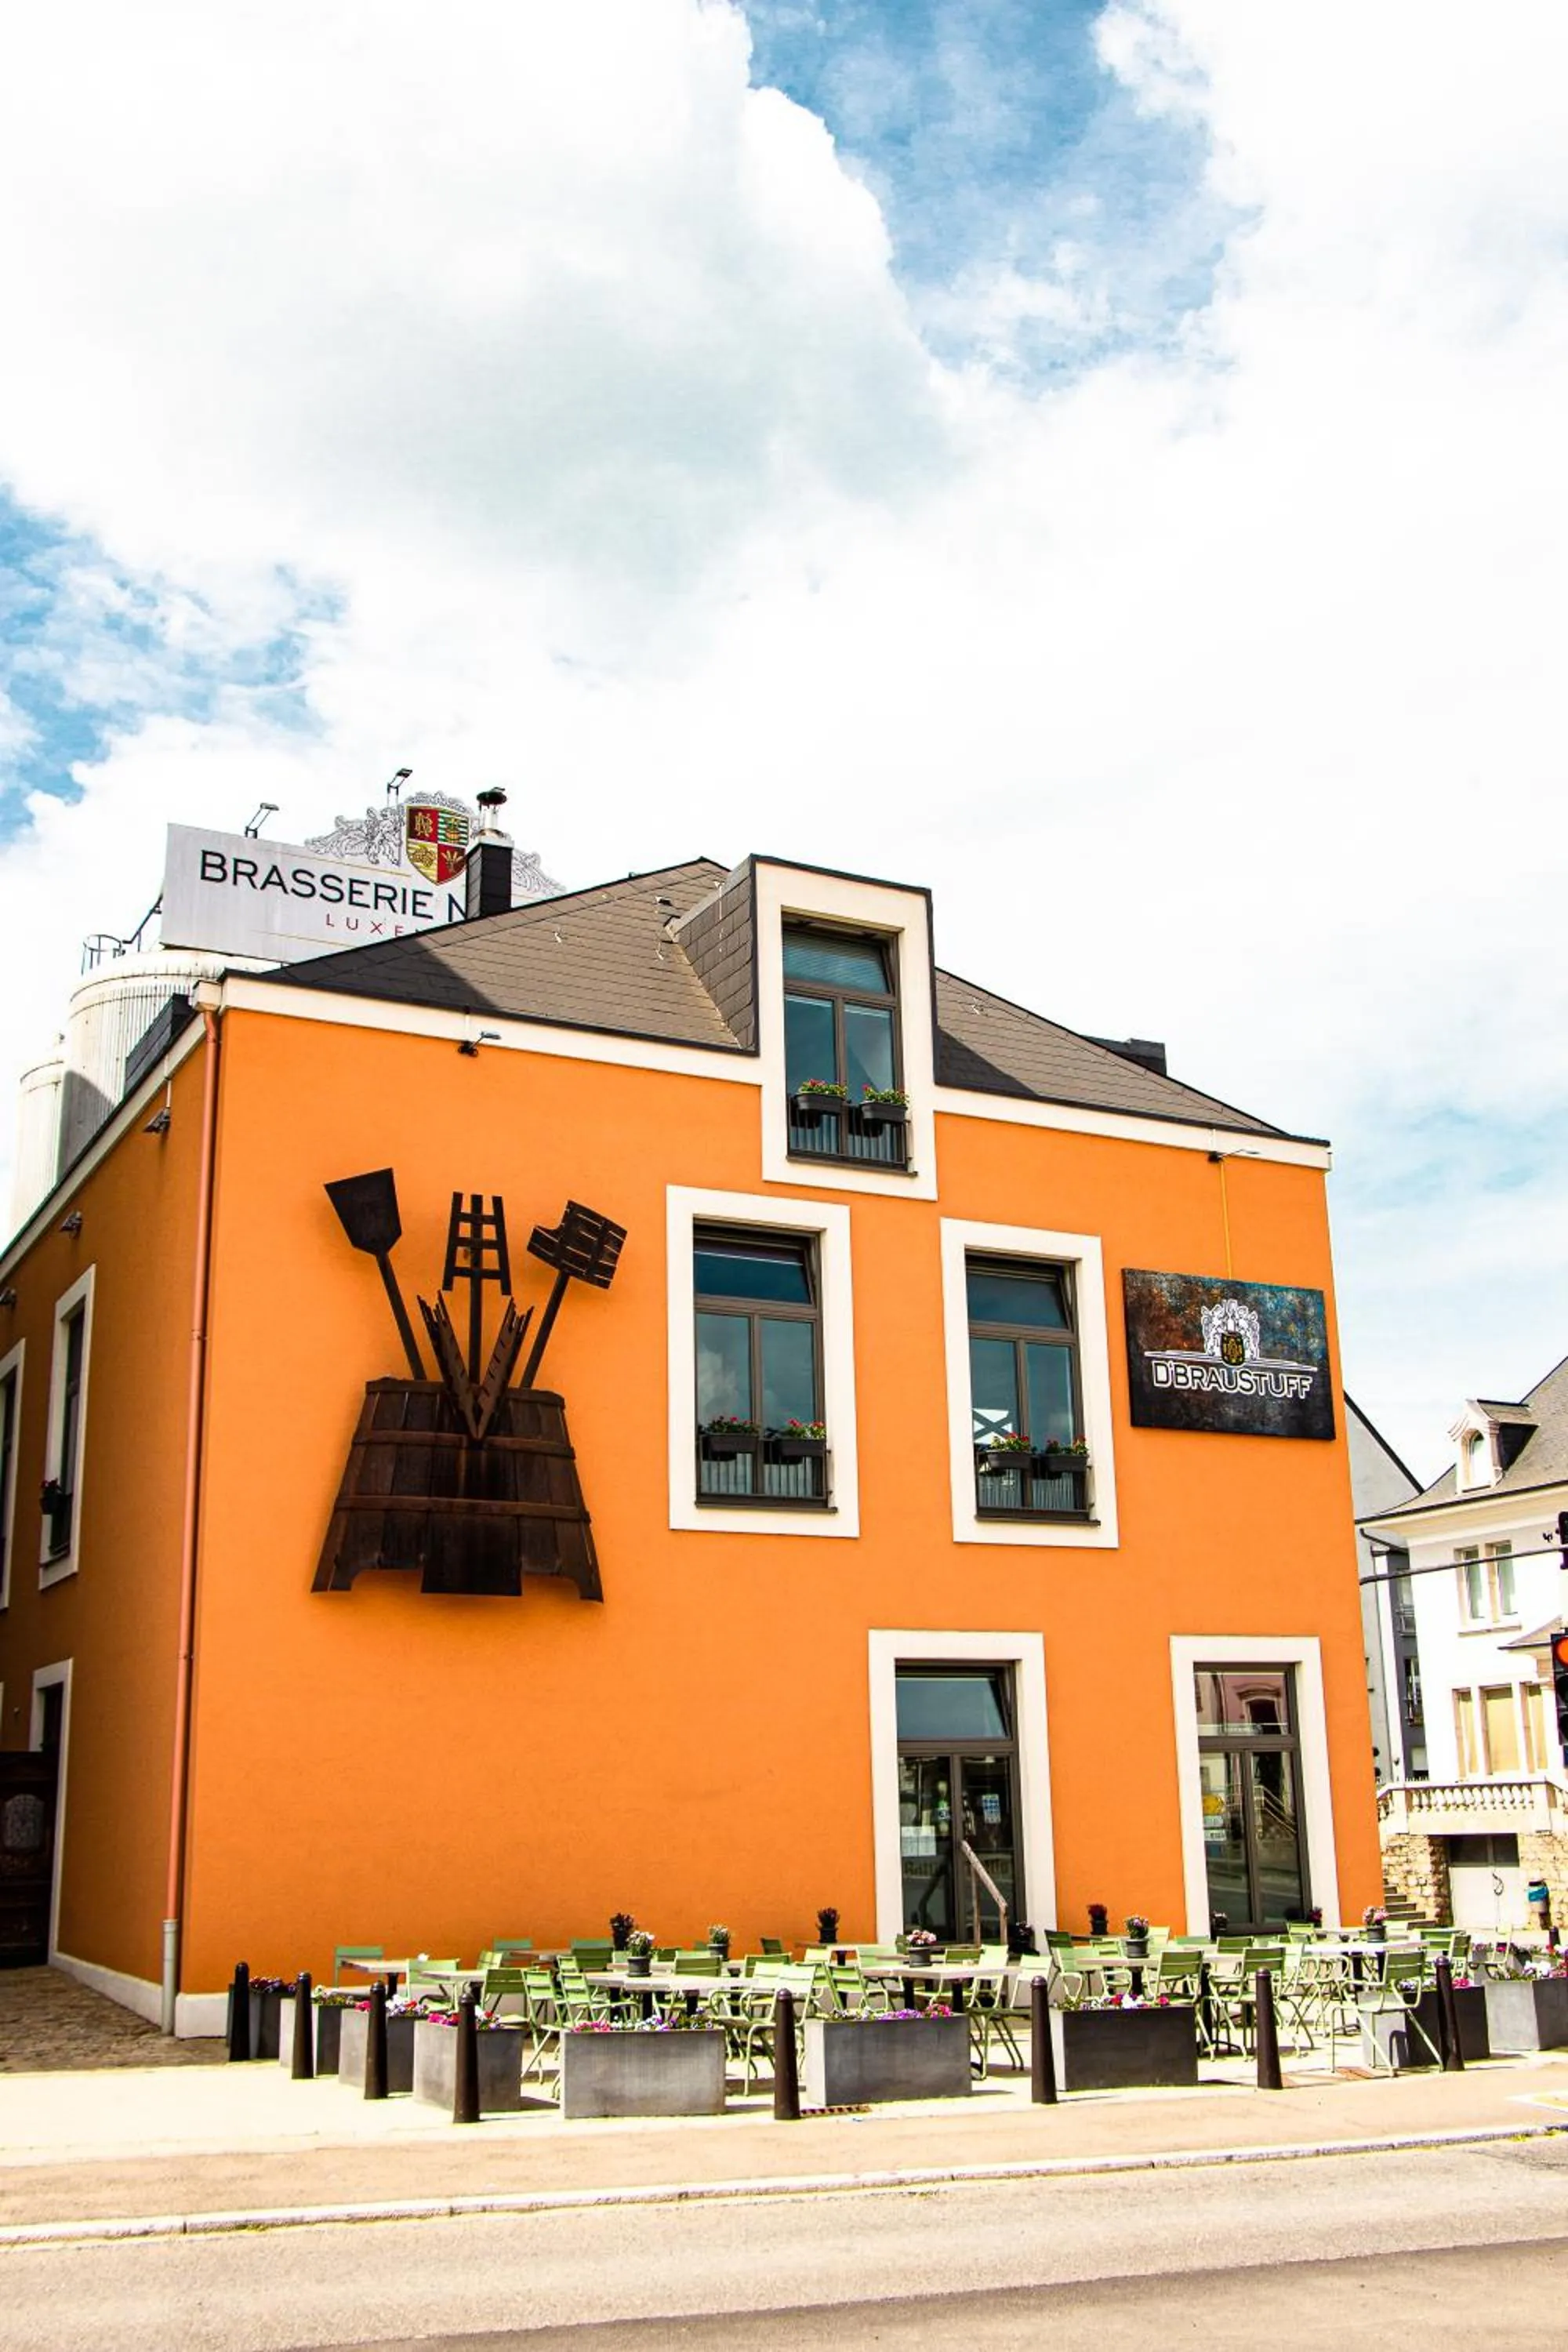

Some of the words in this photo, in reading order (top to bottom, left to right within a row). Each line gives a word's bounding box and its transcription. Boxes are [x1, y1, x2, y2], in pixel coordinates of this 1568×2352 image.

[201, 849, 434, 920] BRASSERIE
[325, 913, 422, 937] LUXE
[1152, 1360, 1313, 1399] D'BRAUSTUFF
